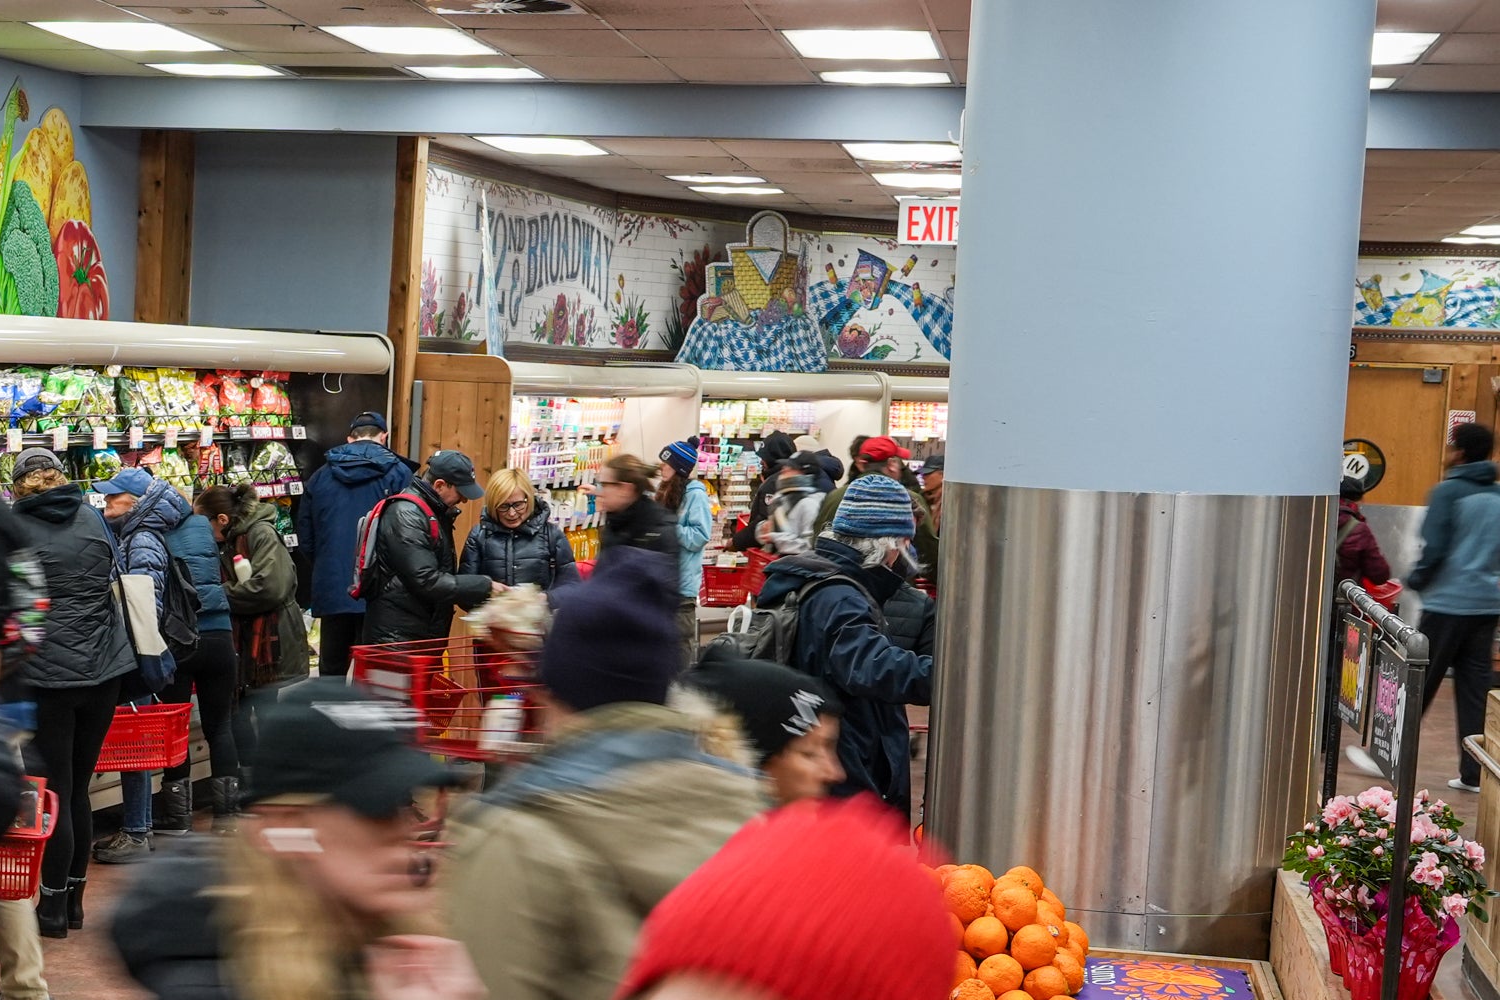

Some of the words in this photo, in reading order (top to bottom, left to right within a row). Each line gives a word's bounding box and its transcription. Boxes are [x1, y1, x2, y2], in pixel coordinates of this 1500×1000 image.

[907, 205, 958, 241] EXIT
[525, 210, 614, 312] BROADWAY
[1346, 458, 1365, 474] IN
